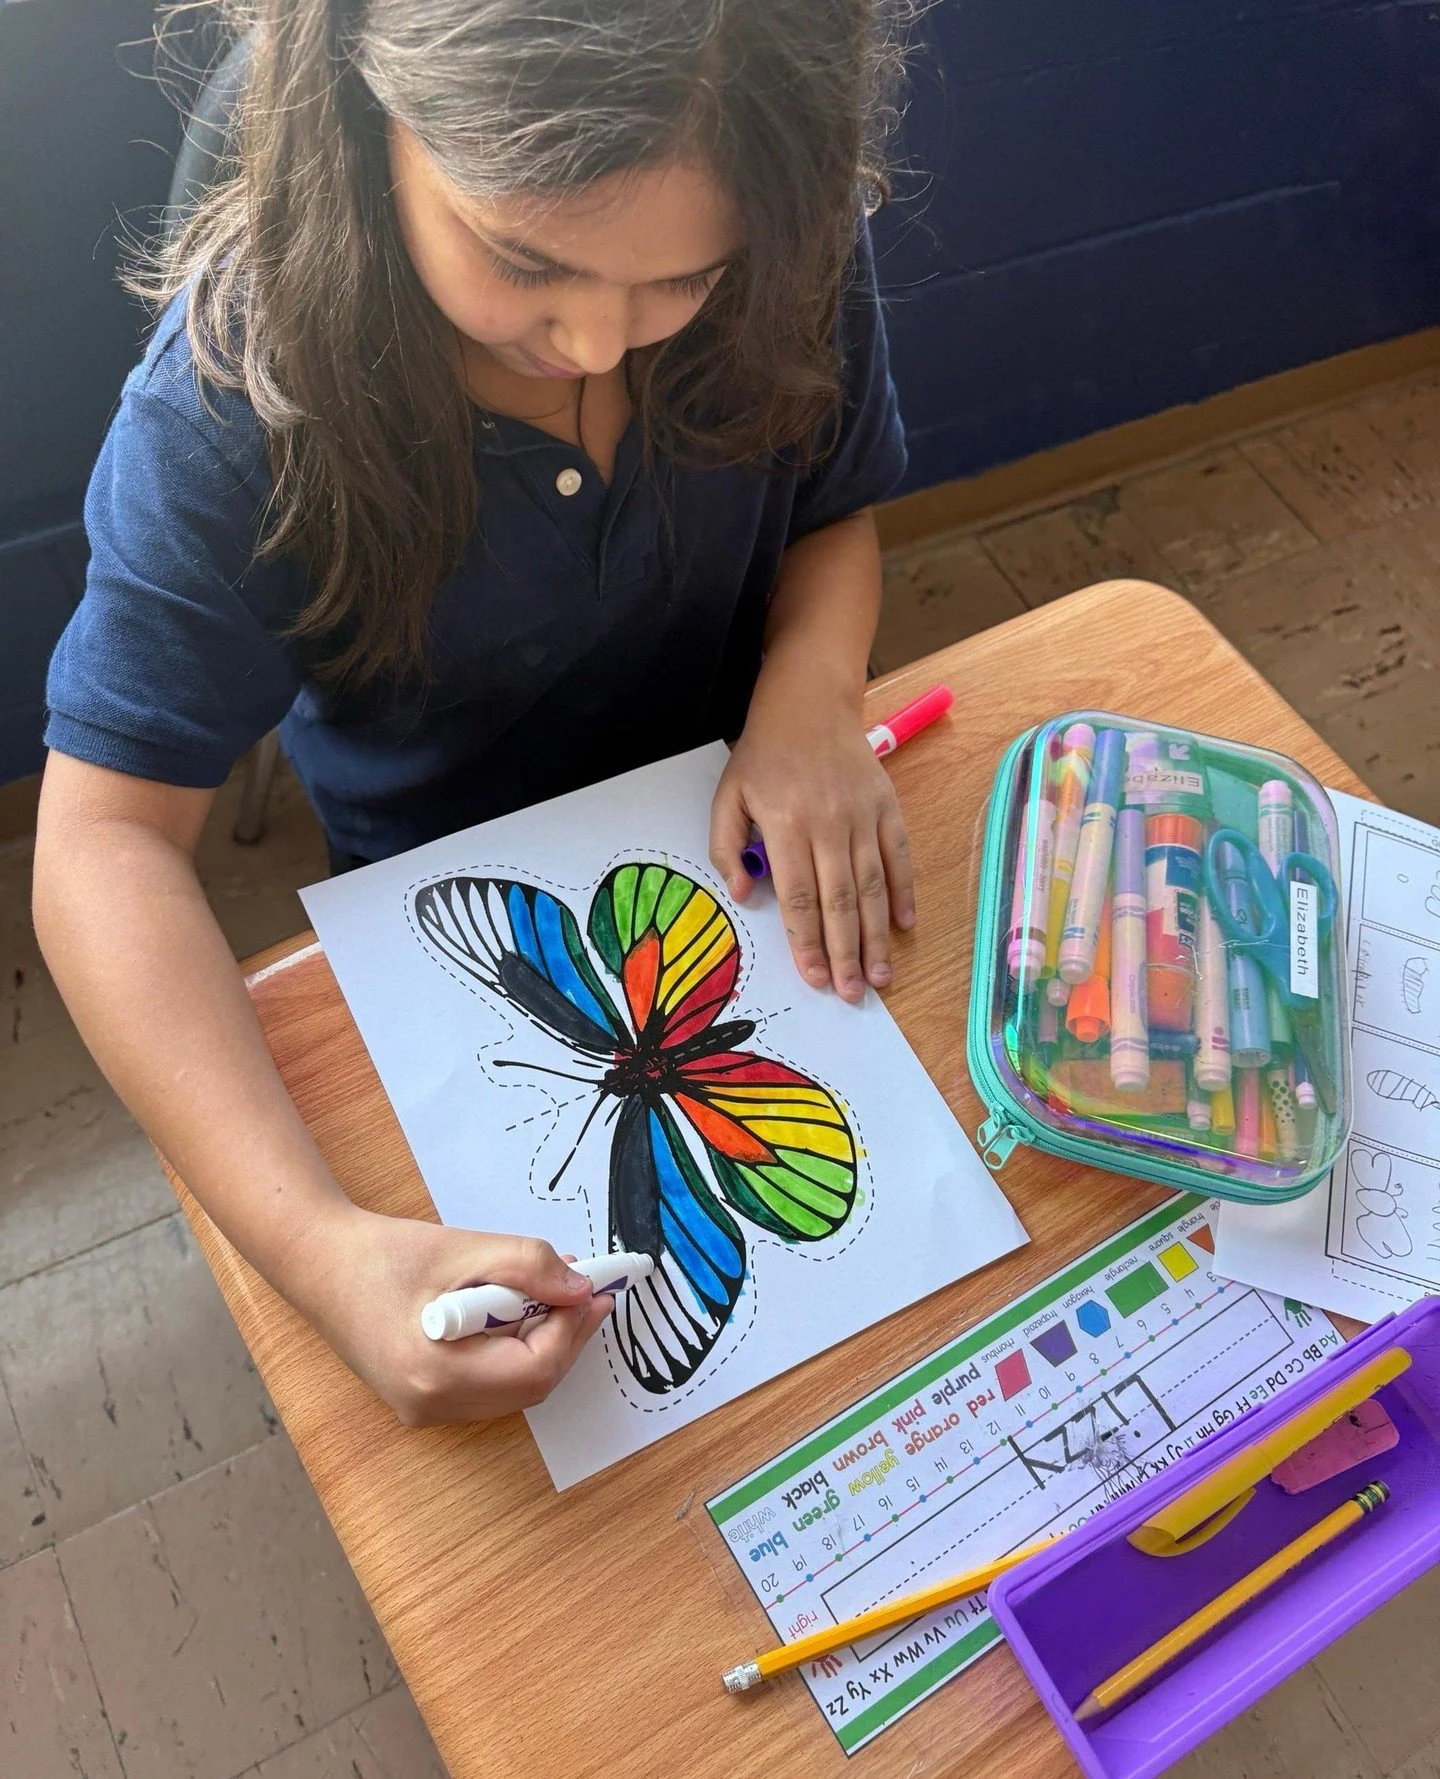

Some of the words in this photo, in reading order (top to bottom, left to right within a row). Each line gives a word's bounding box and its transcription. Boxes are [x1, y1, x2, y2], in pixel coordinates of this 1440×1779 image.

[1121, 773, 1200, 788] Elizabe
[1296, 887, 1309, 976] Elizabeth
[1176, 1212, 1206, 1233] triangle
[1149, 1231, 1174, 1252] square
[1103, 1255, 1138, 1281] rectangle
[1062, 1285, 1095, 1309] hexagon
[1183, 1288, 1195, 1299] 4
[1160, 1303, 1172, 1315] 5
[1022, 1309, 1058, 1338] trapezoid
[1136, 1319, 1148, 1331] 6
[981, 1337, 1015, 1363] rhombus
[1115, 1335, 1124, 1349] 7
[1319, 1330, 1339, 1349] Aa
[1088, 1352, 1100, 1365] 8
[1303, 1343, 1324, 1362] Bb
[1284, 1357, 1305, 1374] Cc
[931, 1362, 982, 1406] purple
[1064, 1371, 1076, 1382] 9
[1265, 1370, 1288, 1392] Dd
[1038, 1385, 1052, 1400] 10
[1249, 1384, 1269, 1400] Ee
[966, 1388, 996, 1419] red
[1014, 1403, 1026, 1417] 11
[1235, 1396, 1252, 1414] Ff
[892, 1398, 927, 1435] pink
[1212, 1409, 1235, 1427] Gg
[904, 1412, 960, 1456] orange
[986, 1420, 1002, 1436] 12
[832, 1430, 889, 1472] brown
[959, 1438, 974, 1455] 13
[1166, 1444, 1183, 1460] Jj
[848, 1447, 900, 1496] yellow
[934, 1456, 948, 1473] 14
[781, 1470, 829, 1510] black
[905, 1475, 921, 1493] 15
[792, 1488, 841, 1532] green
[878, 1494, 893, 1511] 16
[728, 1506, 777, 1543] white
[852, 1513, 866, 1532] 17
[749, 1530, 789, 1562] blue
[821, 1533, 837, 1551] 18
[791, 1554, 808, 1572] 19
[761, 1572, 780, 1593] 20
[968, 1595, 988, 1616] Tt
[788, 1610, 819, 1640] right
[943, 1608, 970, 1630] Uu
[923, 1626, 947, 1647] Vv
[893, 1641, 926, 1668] Ww
[869, 1662, 894, 1684] Xx
[846, 1680, 872, 1701] Yy
[826, 1695, 849, 1716] Zz
